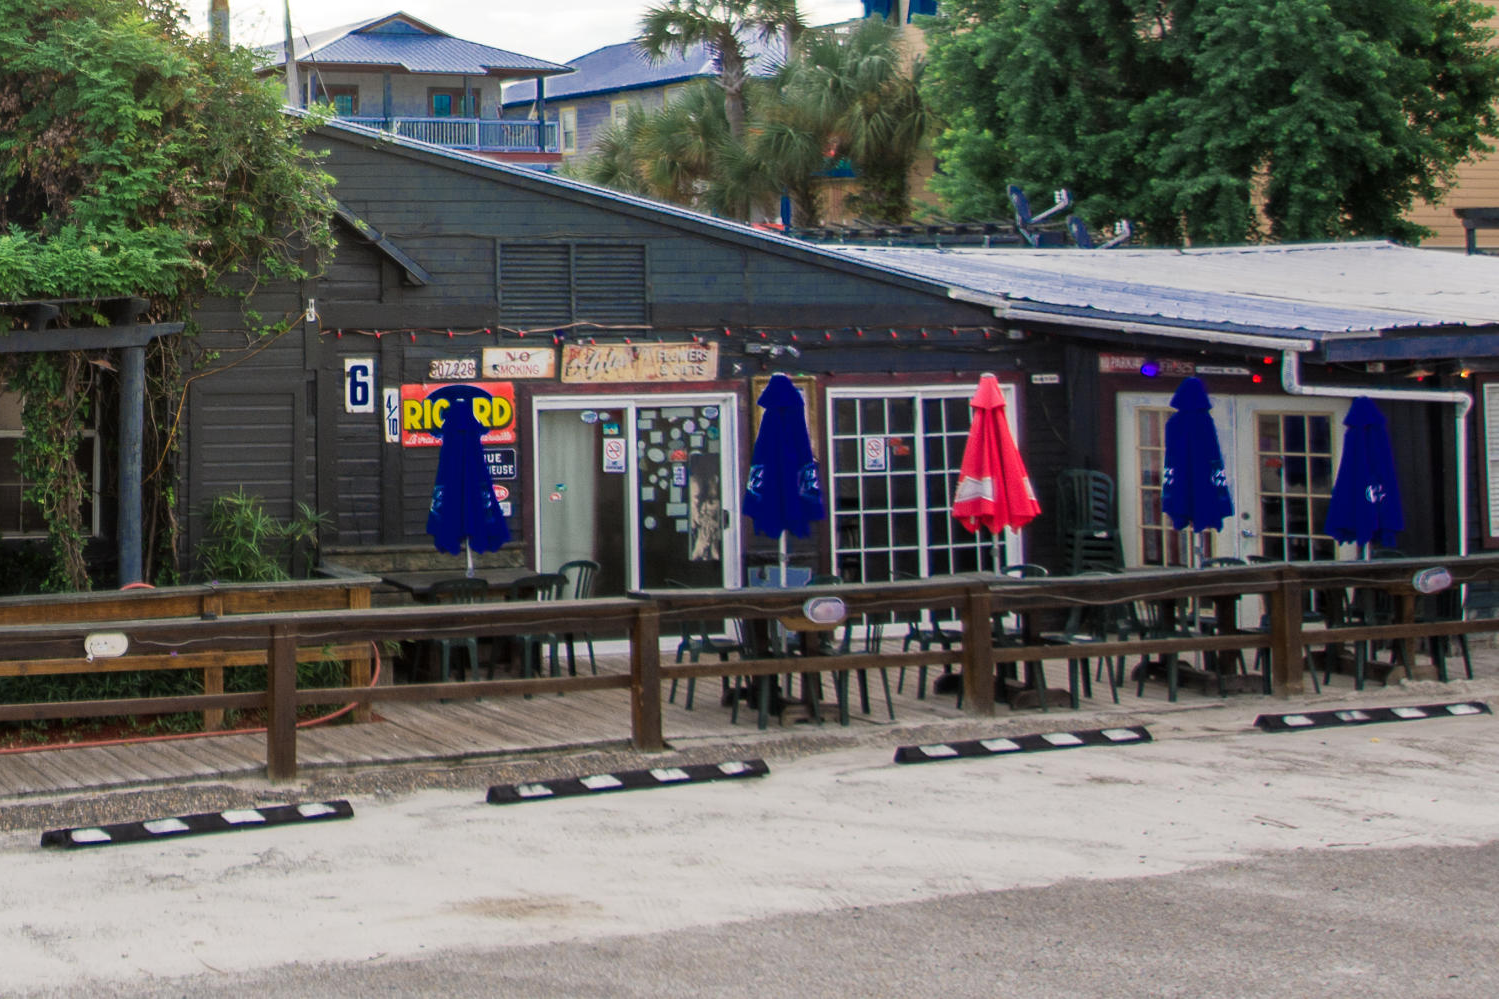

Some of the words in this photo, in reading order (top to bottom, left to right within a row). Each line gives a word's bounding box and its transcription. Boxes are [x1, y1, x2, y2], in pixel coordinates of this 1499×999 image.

[504, 352, 530, 362] NO
[349, 364, 369, 406] 6
[403, 396, 513, 430] RICRD
